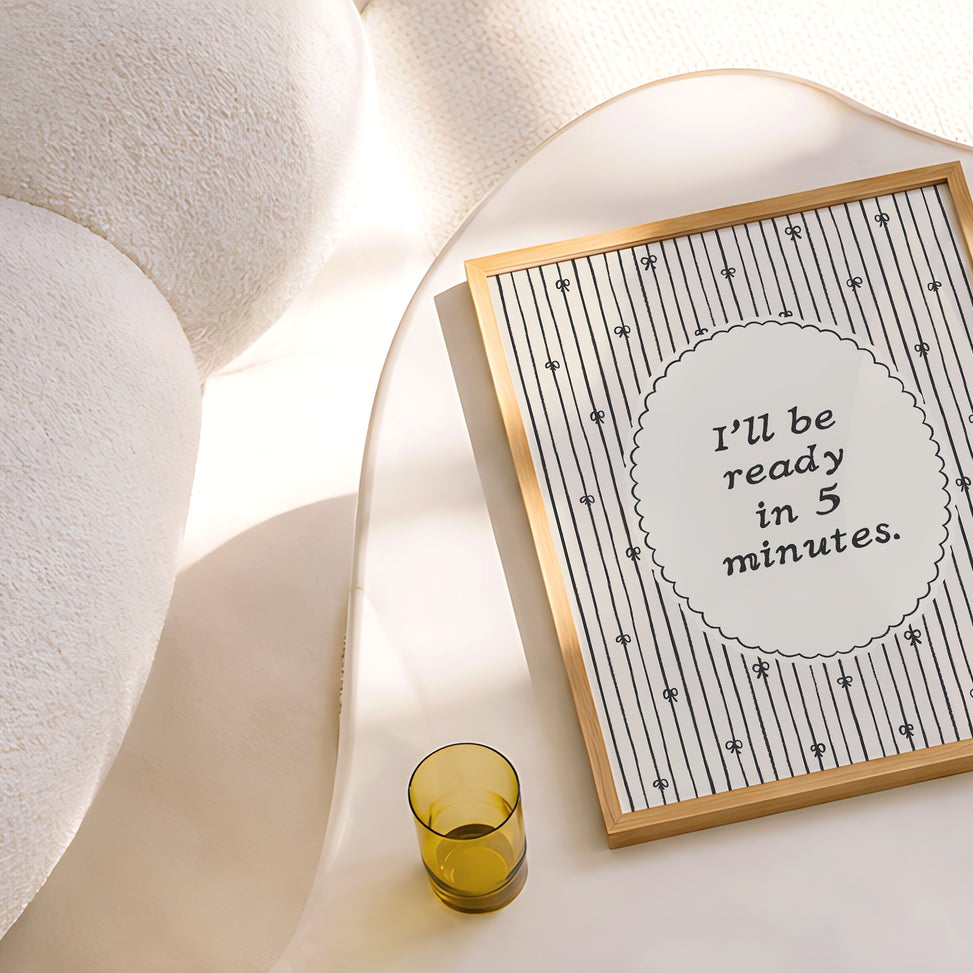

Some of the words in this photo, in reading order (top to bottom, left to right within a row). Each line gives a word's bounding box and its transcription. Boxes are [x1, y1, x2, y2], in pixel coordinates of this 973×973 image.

[713, 413, 775, 452] I'll
[788, 406, 836, 434] be
[723, 444, 844, 490] ready
[756, 501, 799, 529] in
[816, 482, 841, 515] 5
[723, 523, 901, 576] minutes.
